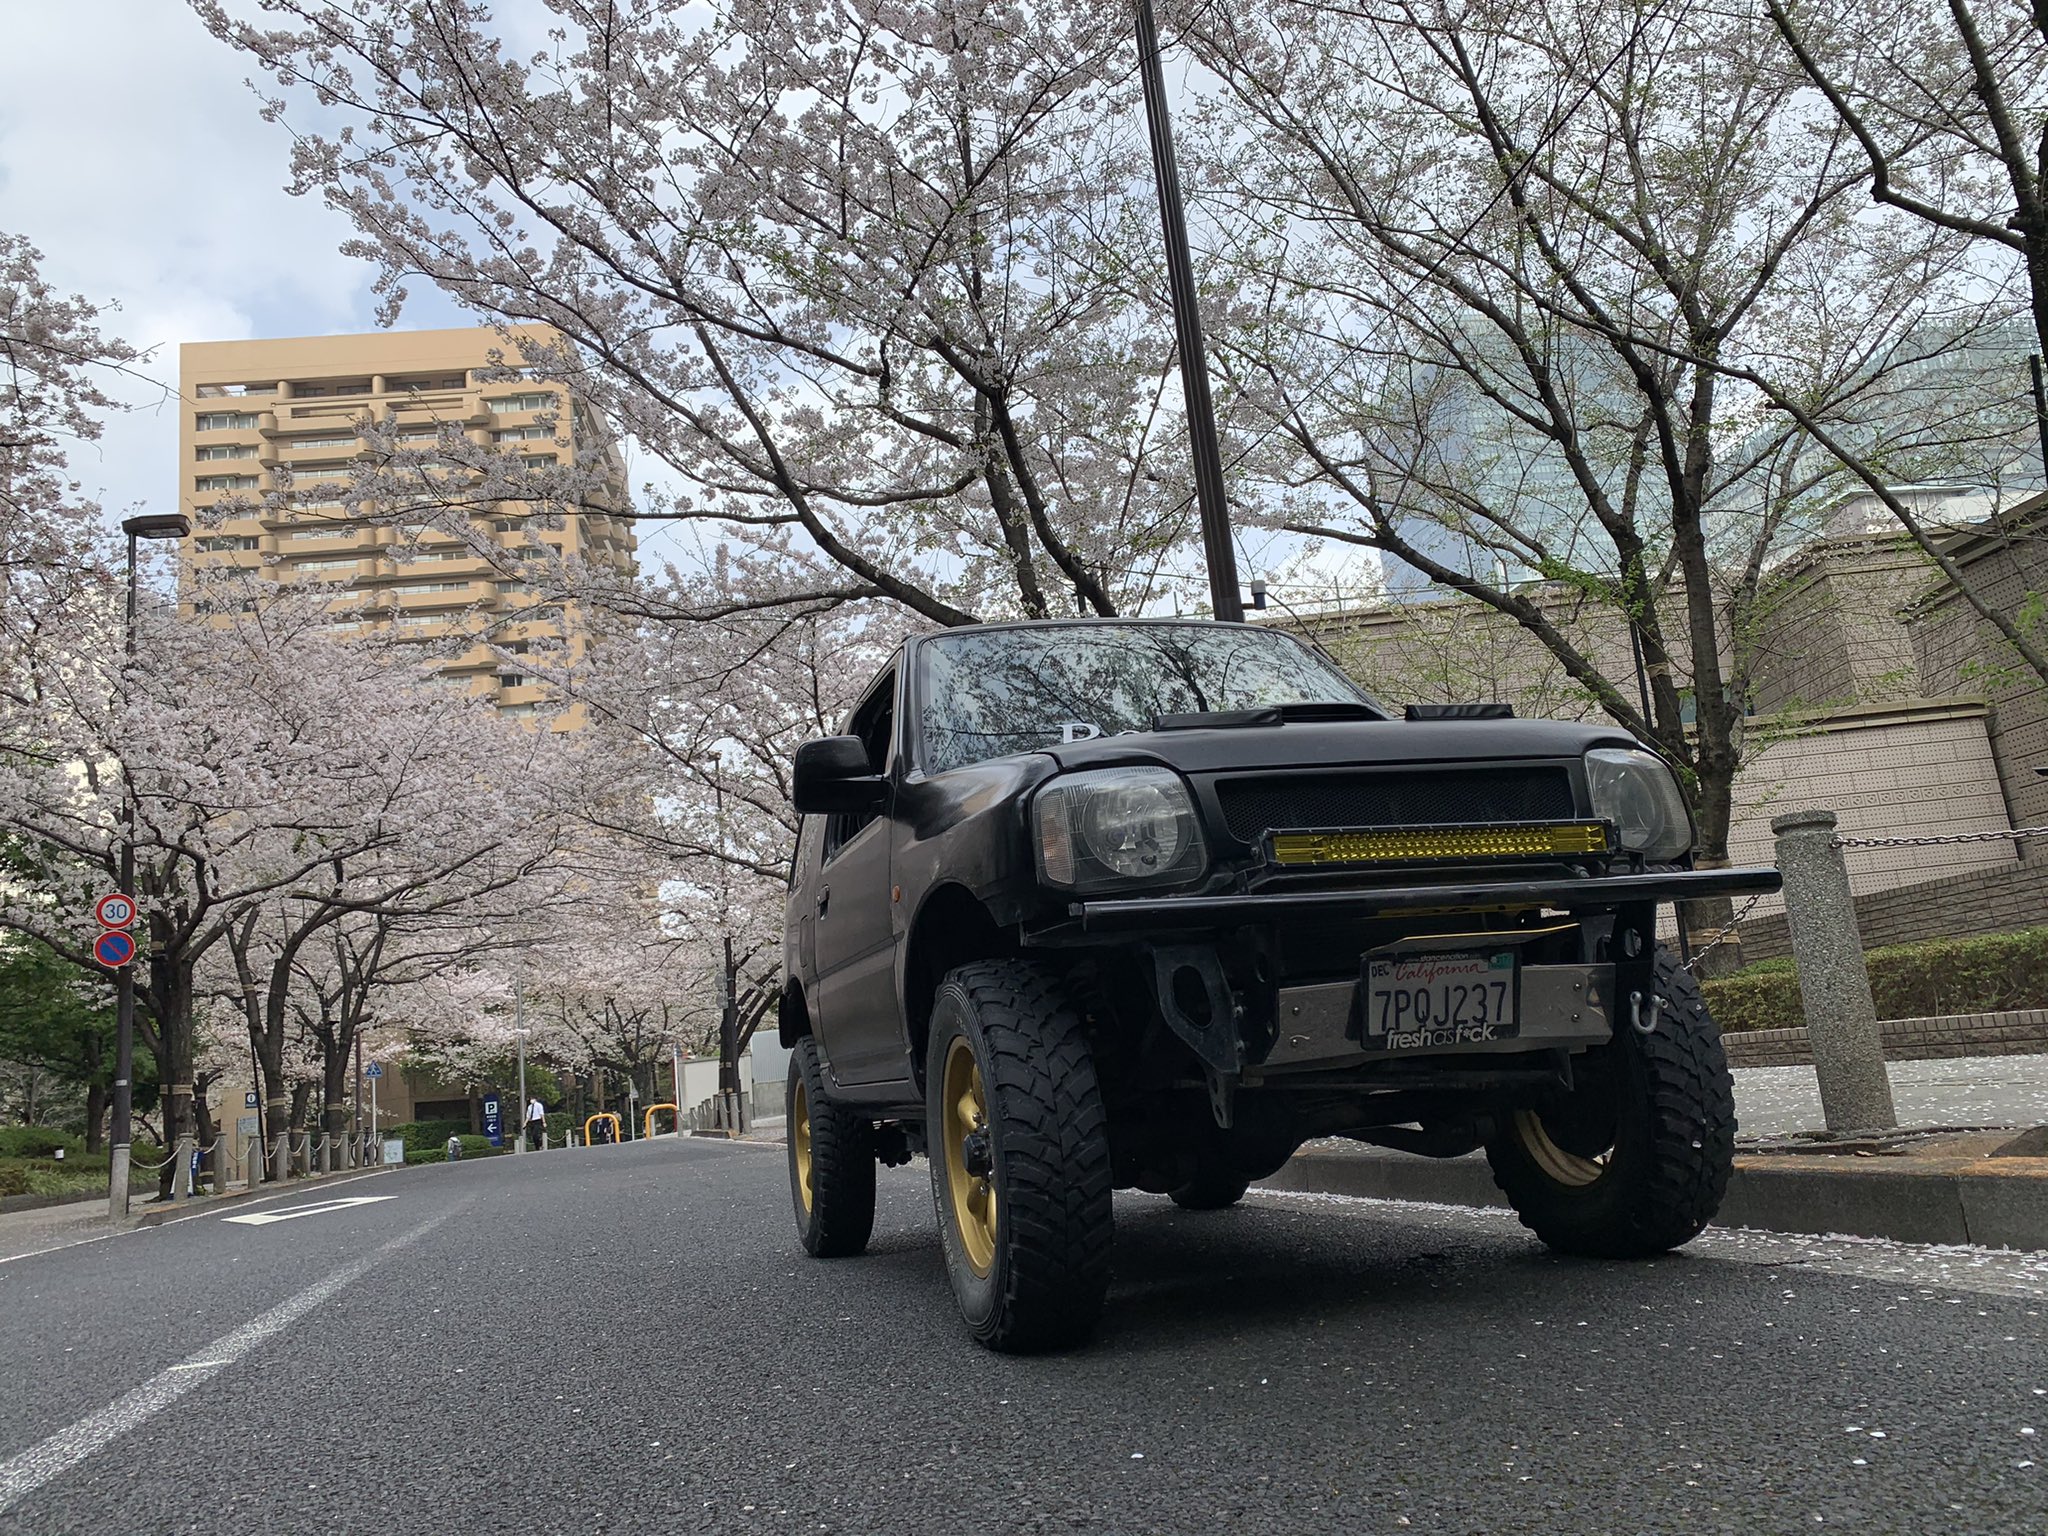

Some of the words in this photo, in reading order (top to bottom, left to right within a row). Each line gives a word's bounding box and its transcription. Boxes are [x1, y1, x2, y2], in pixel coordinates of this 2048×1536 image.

[105, 903, 127, 919] 30
[1371, 963, 1390, 978] DEC
[1395, 960, 1488, 984] California
[1374, 981, 1507, 1032] 7PQJ237
